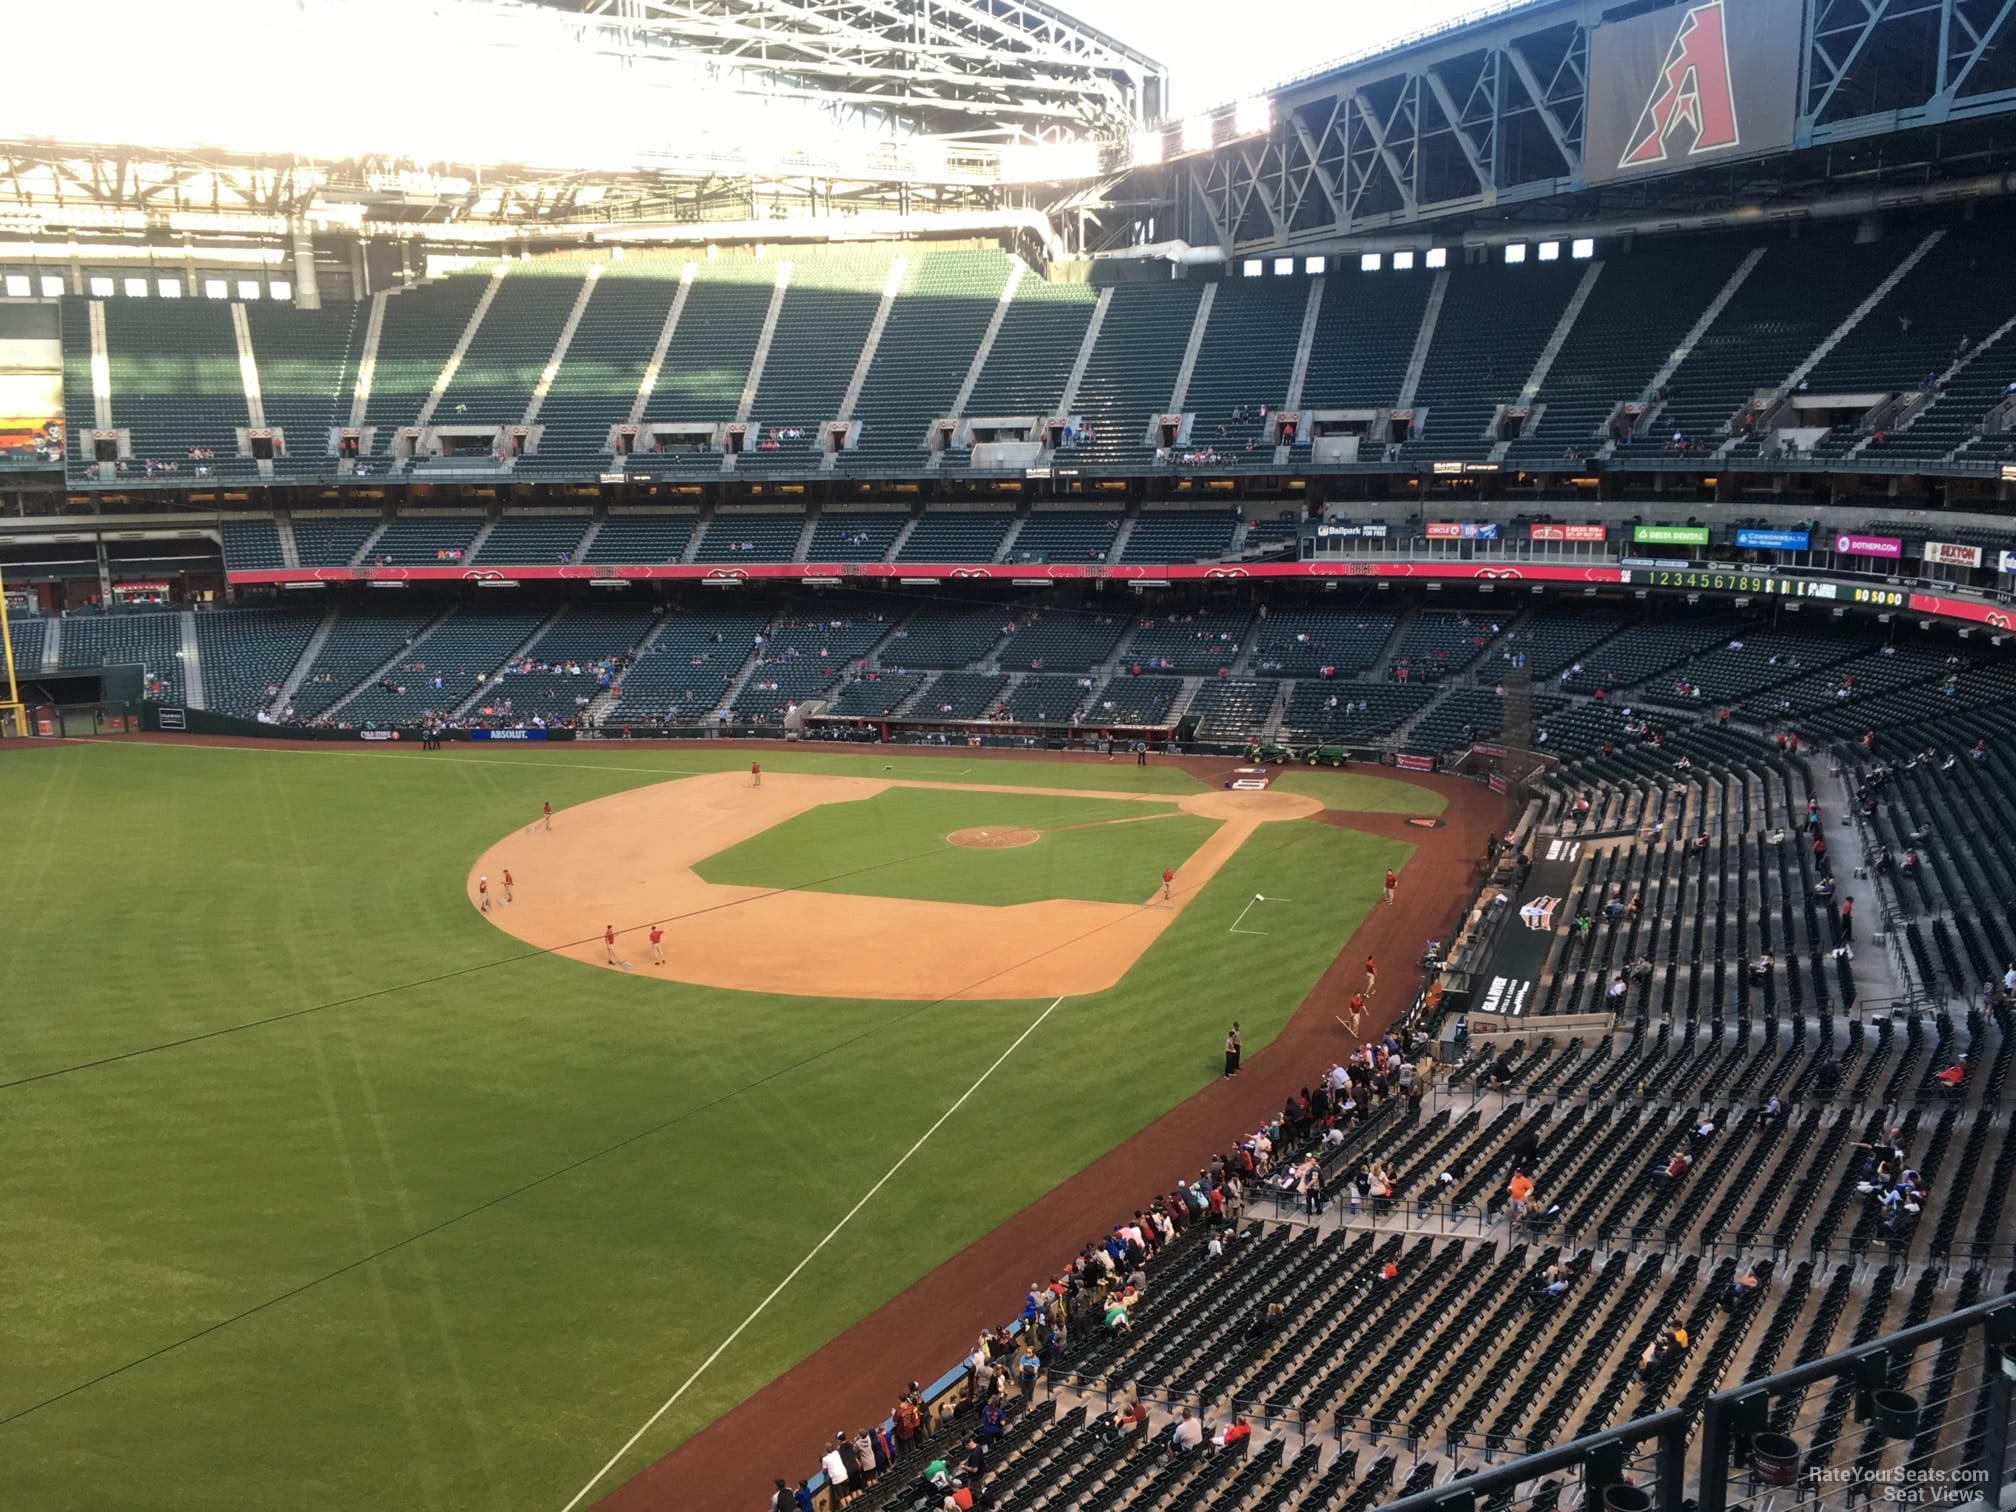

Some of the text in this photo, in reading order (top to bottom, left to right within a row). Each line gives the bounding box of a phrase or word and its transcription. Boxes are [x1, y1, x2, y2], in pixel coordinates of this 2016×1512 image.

[1329, 526, 1361, 536] Ballpark
[1939, 544, 1976, 561] SEXTON
[1660, 572, 1669, 585] 2
[1674, 572, 1683, 586] 3
[1687, 574, 1696, 587] 4
[1701, 574, 1709, 588] 5
[1714, 575, 1723, 588] 6
[1728, 576, 1736, 589] 7
[1739, 577, 1748, 590] 8
[1752, 578, 1761, 592] 9
